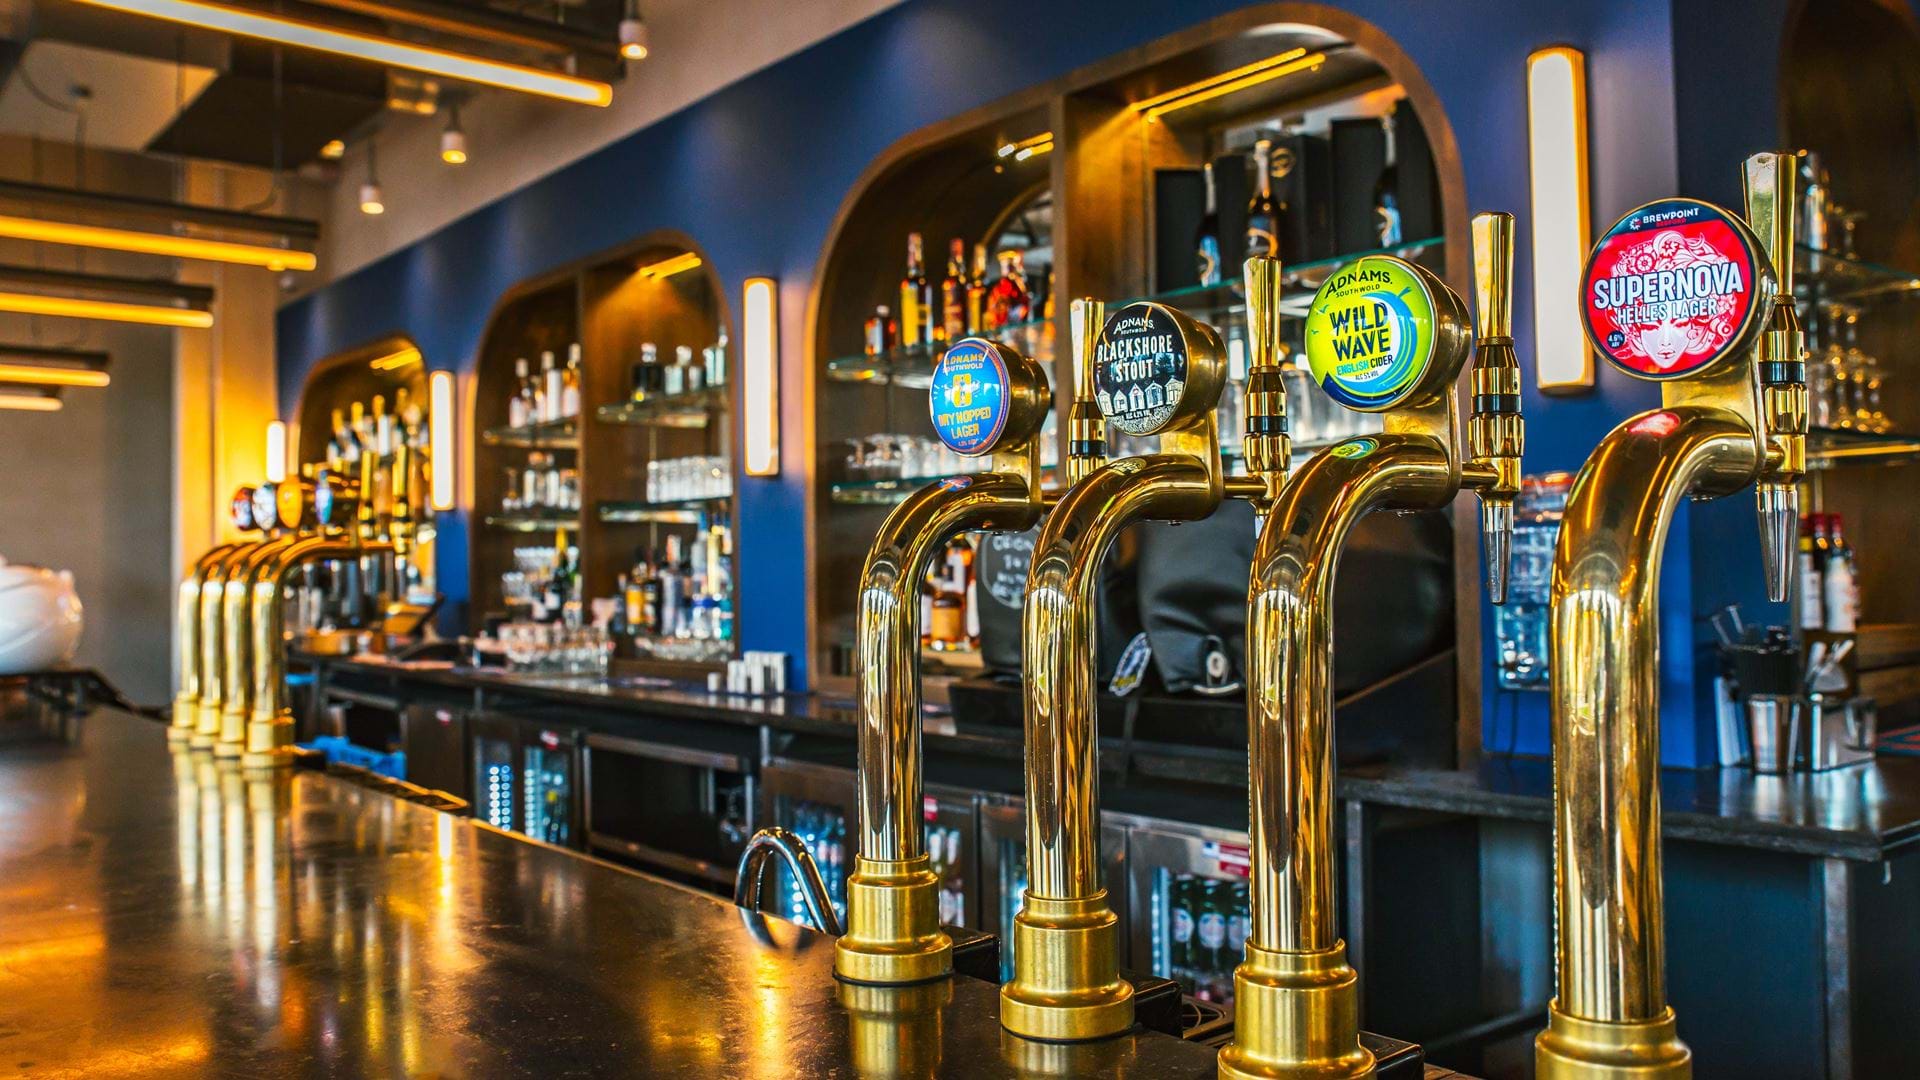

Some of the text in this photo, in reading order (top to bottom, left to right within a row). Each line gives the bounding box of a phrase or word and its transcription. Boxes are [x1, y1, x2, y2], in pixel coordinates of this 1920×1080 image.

[1643, 208, 1699, 223] BREWPOINT
[1336, 284, 1381, 299] SOUTHWOLD
[1594, 262, 1744, 310] SUPERNOVA
[1330, 302, 1389, 336] WILD
[1617, 298, 1718, 325] HELLES LAGER
[1097, 334, 1173, 363] BLACKSHORE
[1332, 328, 1392, 362] WAVE
[945, 353, 984, 366] ADNAMS
[1115, 359, 1153, 383] STOUT
[1336, 354, 1394, 376] ENGLISH CIDER
[951, 423, 980, 440] LAGER
